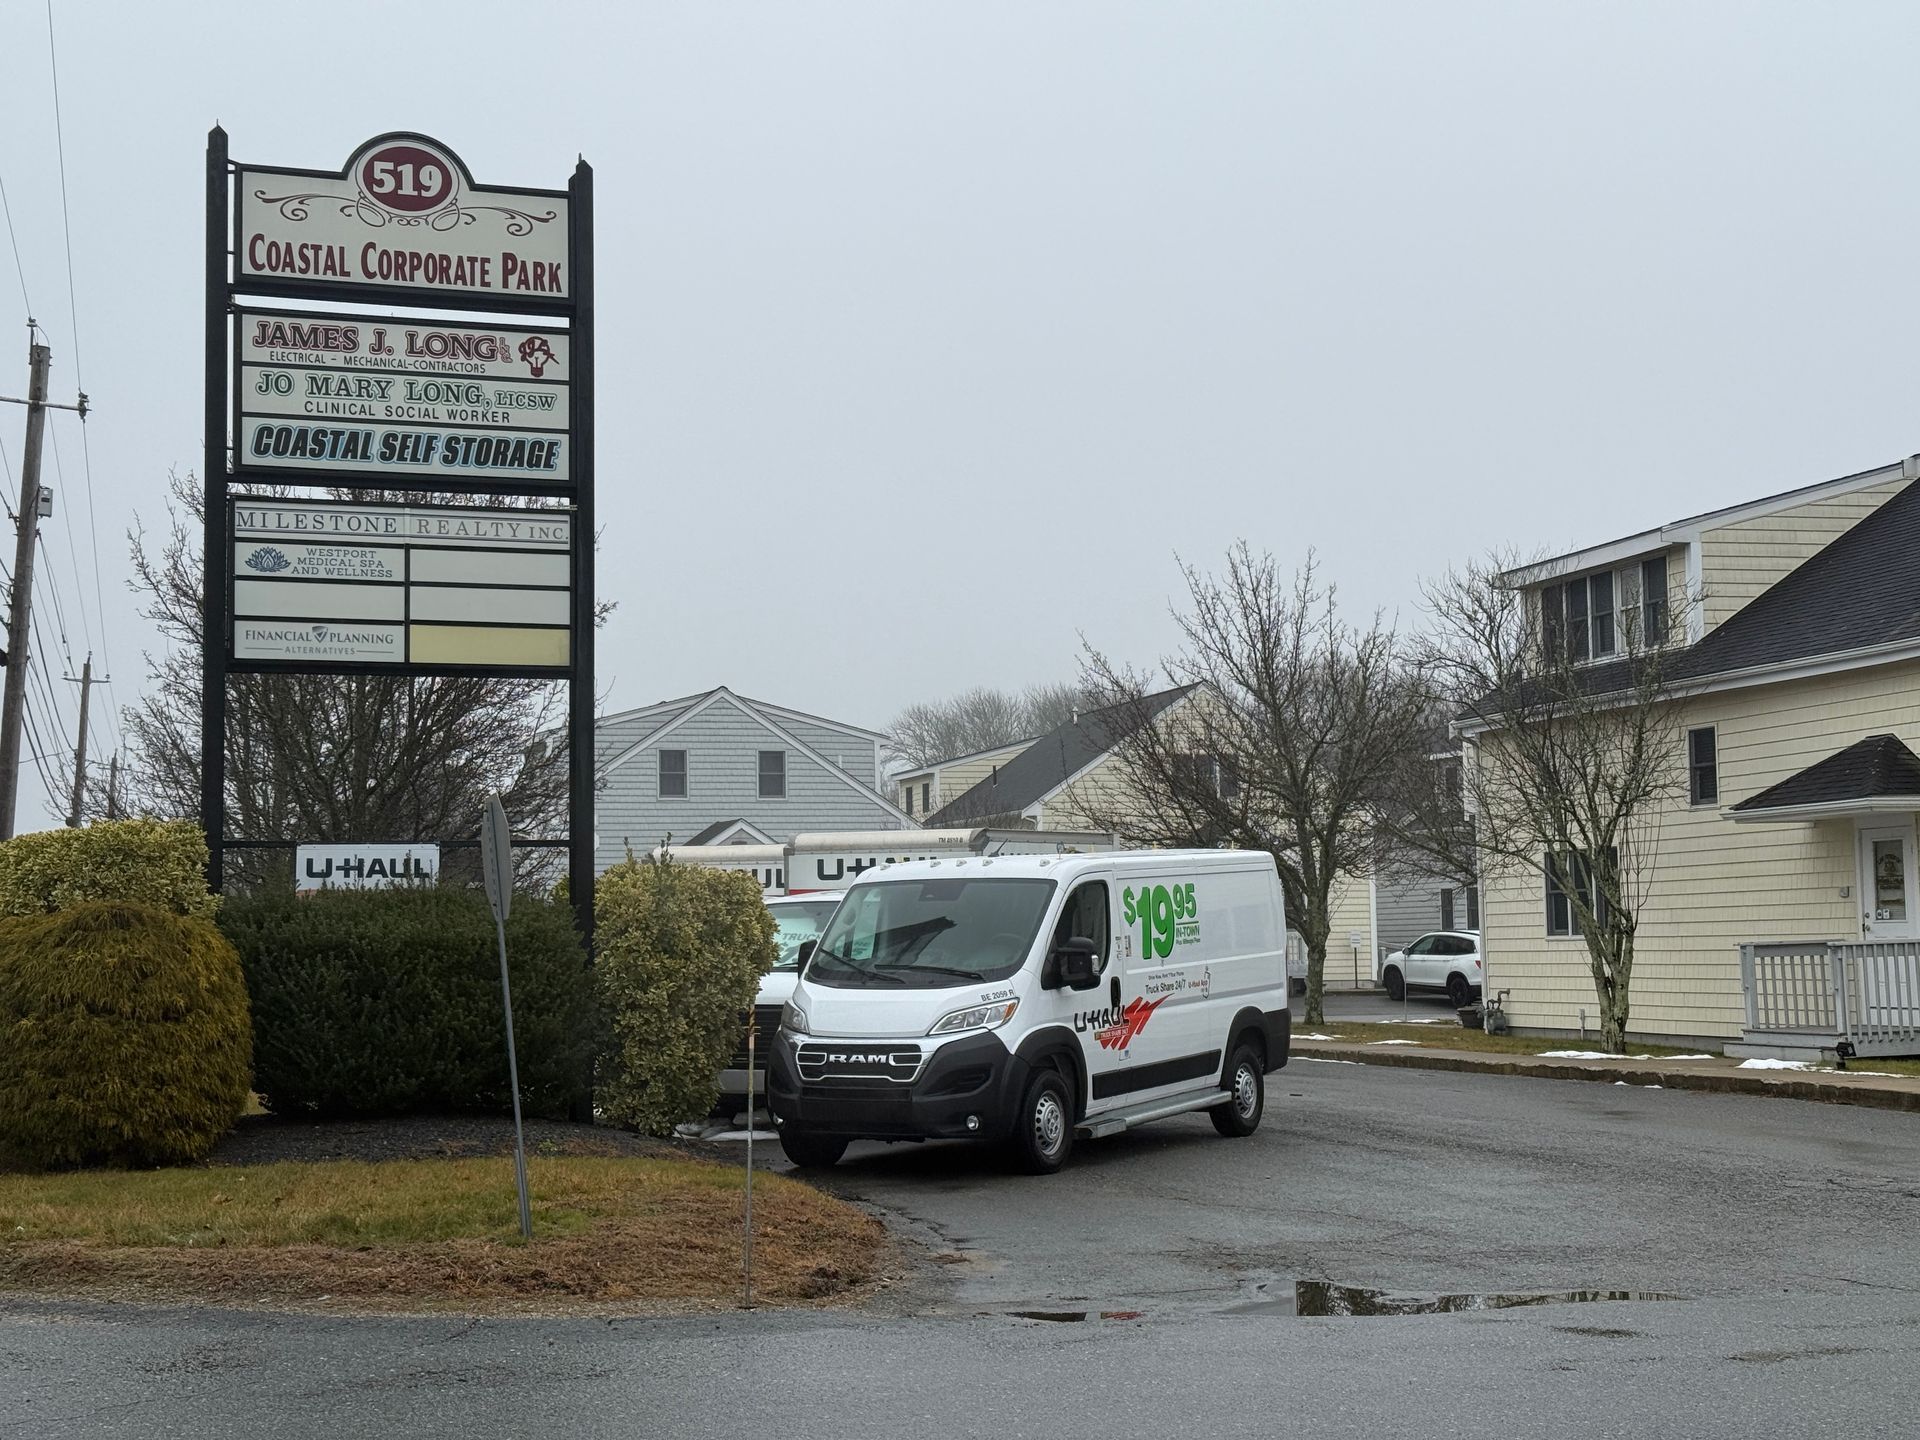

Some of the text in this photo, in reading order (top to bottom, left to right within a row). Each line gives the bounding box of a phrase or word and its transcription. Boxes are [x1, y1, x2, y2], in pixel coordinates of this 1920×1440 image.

[372, 161, 444, 199] 519
[250, 233, 563, 294] COASTAL CORPORATE PARK
[253, 321, 360, 353] JAMES
[369, 328, 394, 356] J.
[405, 331, 498, 362] LONG
[269, 350, 327, 365] ELECTRICAL
[255, 370, 557, 411] JO MARY LONG, LICSW
[304, 400, 511, 424] CLINICAL SOCIAL WORKER
[251, 423, 561, 471] COASTAL SELF STORAGE
[235, 511, 569, 540] MILESTONE REALTY INC.
[305, 547, 377, 559] WESTPORT
[291, 566, 393, 578] AND WELLNESS
[297, 557, 385, 569] MEDICAL SPA
[245, 629, 394, 645] FINANCIAL PLANNING
[284, 646, 356, 656] ALTERNATIVES
[306, 857, 430, 879] U-HAUL
[1176, 925, 1200, 938] IN-TOWN
[1145, 984, 1159, 994] Truck
[1160, 982, 1174, 992] Share
[1175, 979, 1186, 991] 24/7
[1074, 1005, 1129, 1033] U-HAUL
[829, 1054, 887, 1063] RAM
